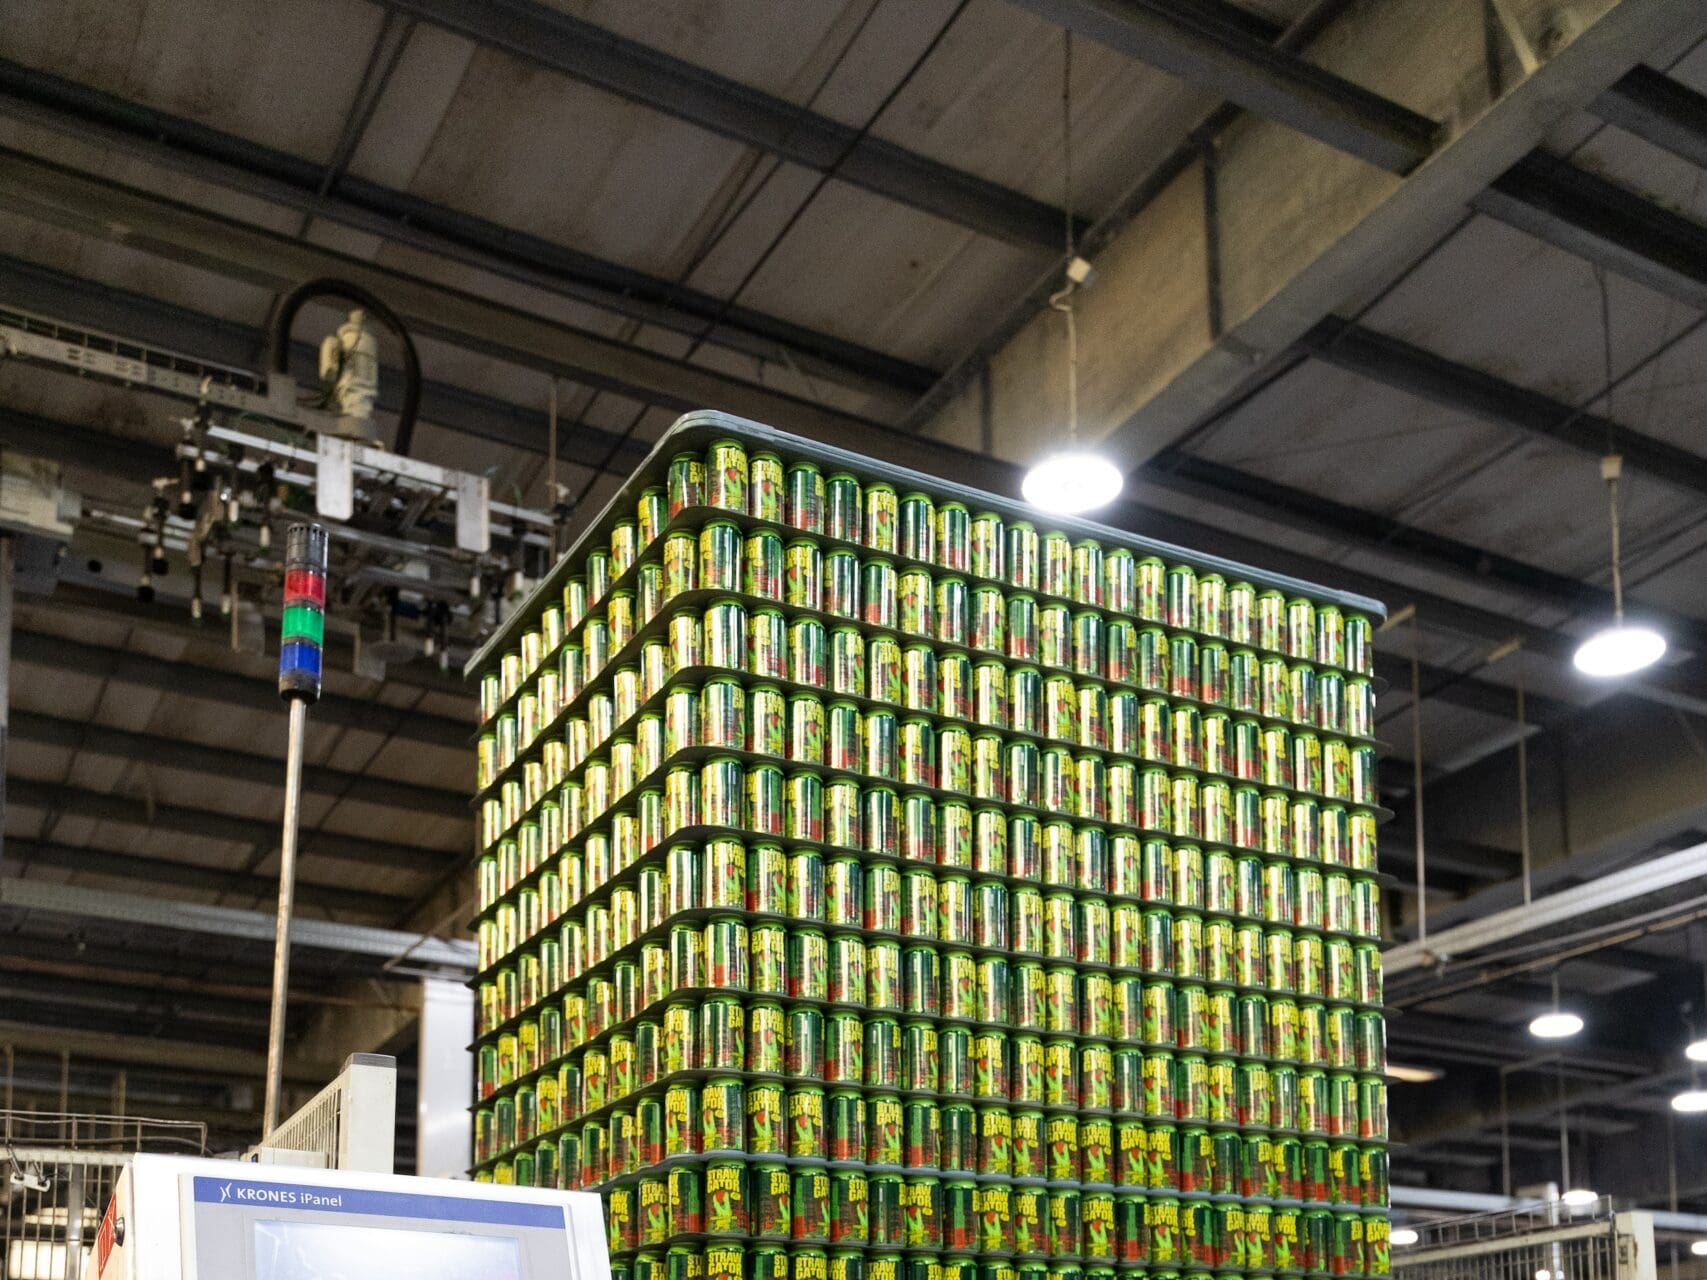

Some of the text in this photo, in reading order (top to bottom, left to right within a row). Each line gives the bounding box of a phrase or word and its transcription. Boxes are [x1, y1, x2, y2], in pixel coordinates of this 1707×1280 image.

[707, 1169, 740, 1180] STRAW
[707, 1180, 740, 1194] GATOR
[236, 1187, 342, 1207] KRONES iPanel
[709, 1252, 742, 1263] STRAW
[709, 1262, 742, 1276] GATOR
